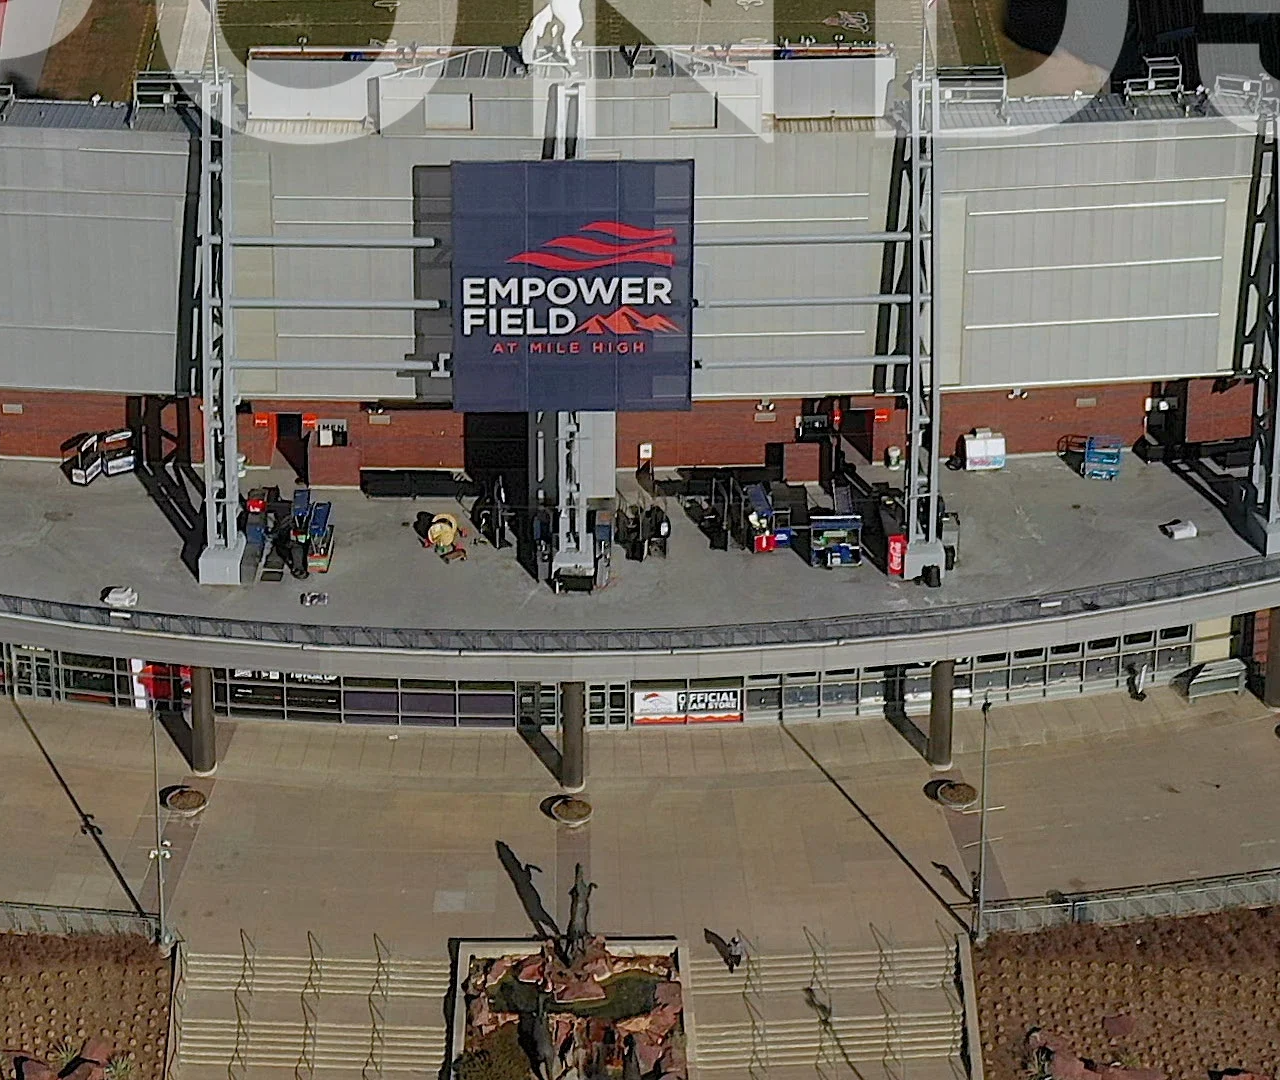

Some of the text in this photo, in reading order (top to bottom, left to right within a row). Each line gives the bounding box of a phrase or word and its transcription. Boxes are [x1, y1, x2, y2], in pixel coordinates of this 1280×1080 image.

[462, 276, 672, 306] EMPOWER
[462, 307, 578, 336] FIELD
[492, 341, 646, 354] AT MILE HIGH
[678, 691, 737, 703] OFFICIAL
[707, 701, 737, 710] STORE
